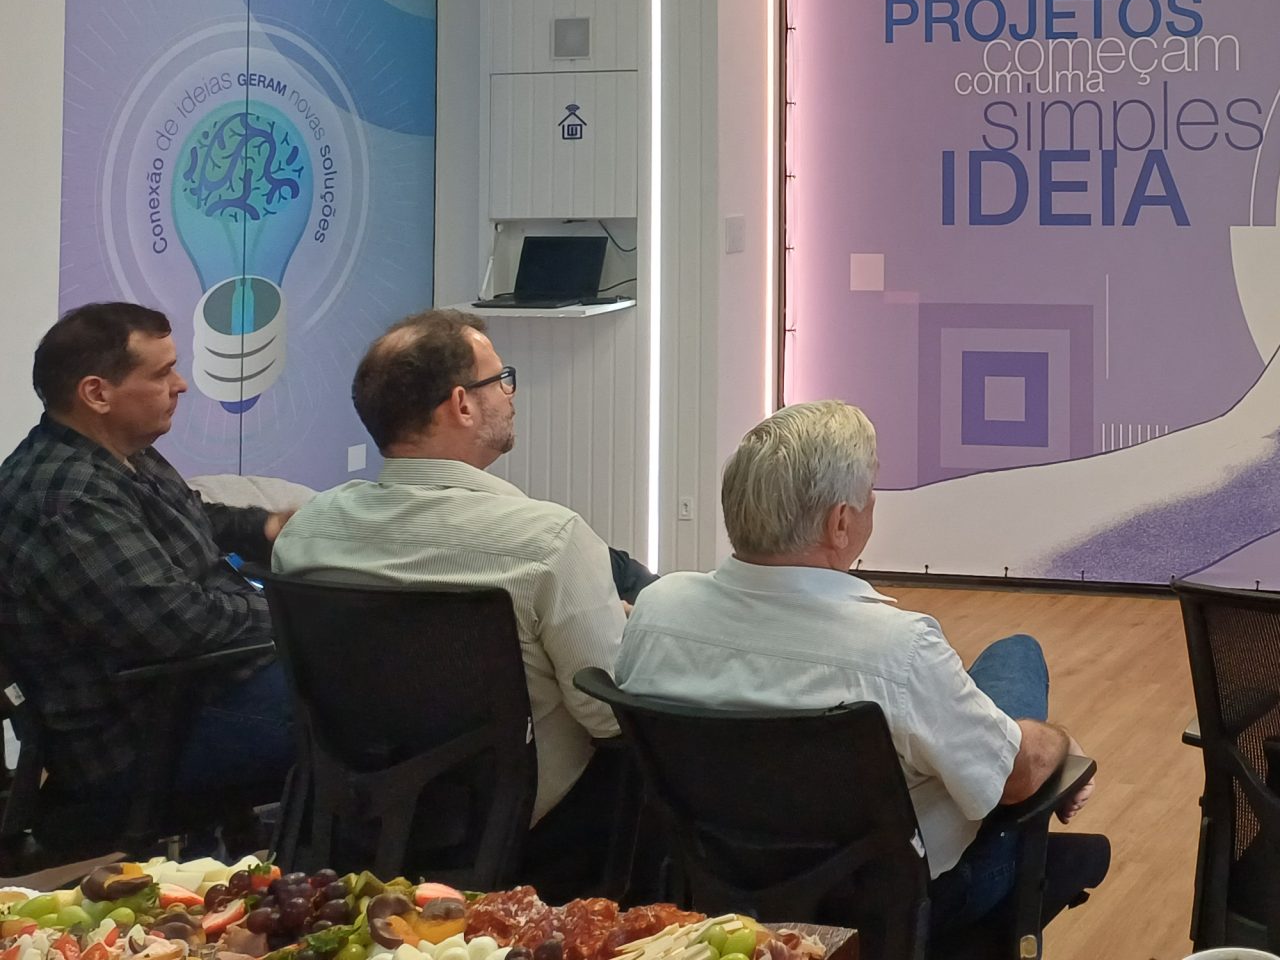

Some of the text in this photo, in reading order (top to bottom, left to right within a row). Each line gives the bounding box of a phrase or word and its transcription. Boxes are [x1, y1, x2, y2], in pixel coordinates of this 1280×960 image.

[954, 68, 1105, 95] com uma
[983, 34, 1240, 86] começam
[146, 72, 338, 254] Conexão de ideias GERAM novas soluções
[982, 80, 1264, 168] simples
[941, 149, 1191, 227] IDEIA
